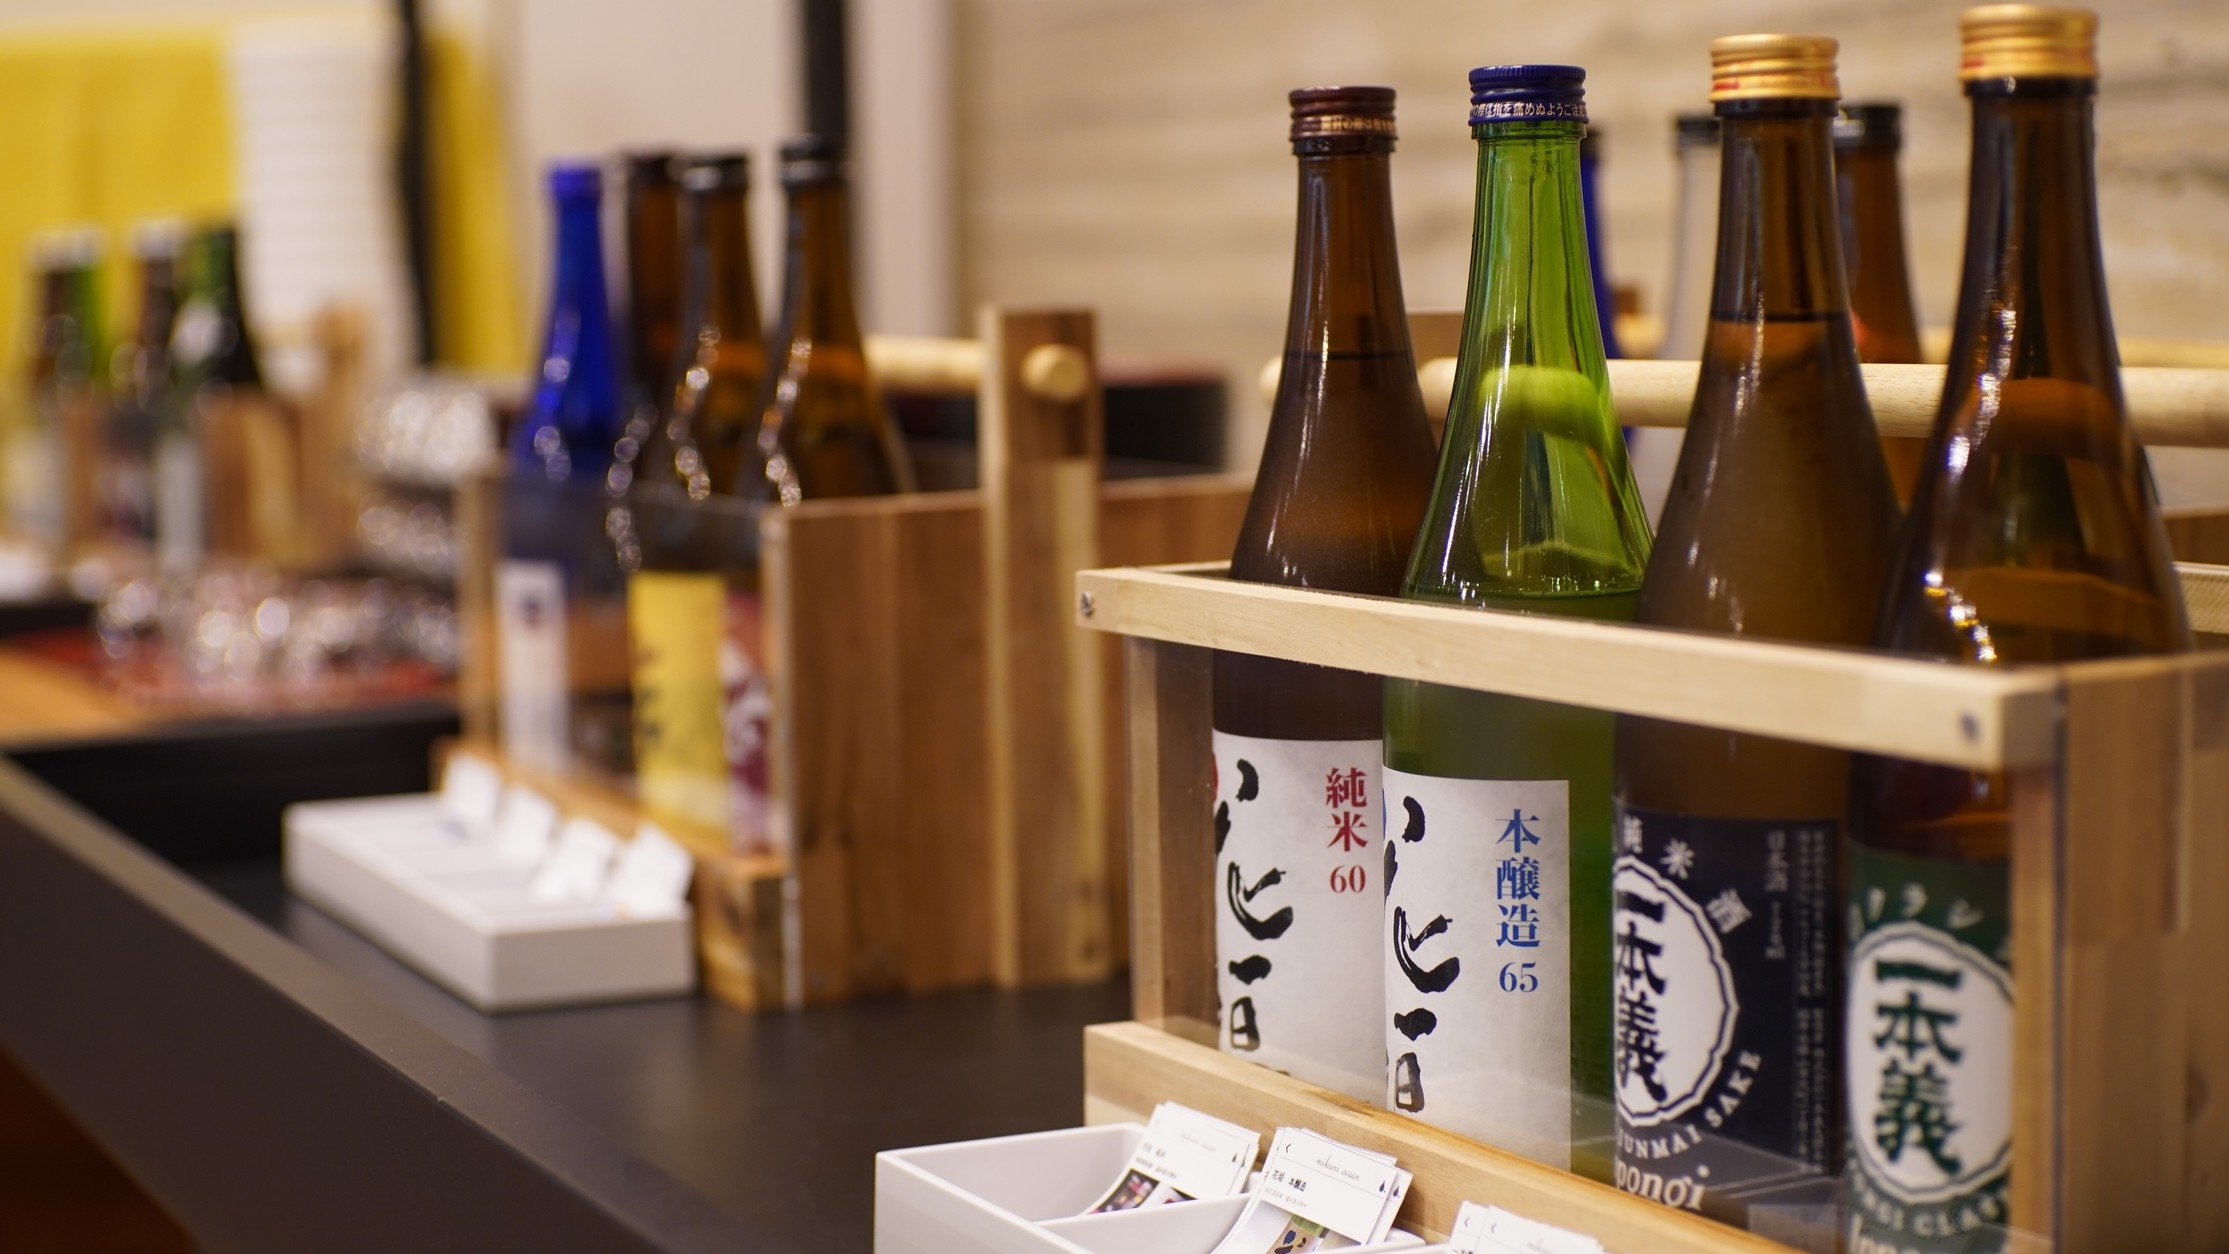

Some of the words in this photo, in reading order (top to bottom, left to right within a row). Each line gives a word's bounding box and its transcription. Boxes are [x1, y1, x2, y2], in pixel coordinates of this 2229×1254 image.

[1325, 767, 1368, 852] 純米
[1329, 864, 1366, 894] 60
[1495, 808, 1540, 948] 本醸造
[1499, 961, 1538, 993] 65
[1618, 1123, 1702, 1160] JUNMAI
[1704, 1050, 1762, 1129] SAKE
[1873, 959, 1963, 1176] 一本義
